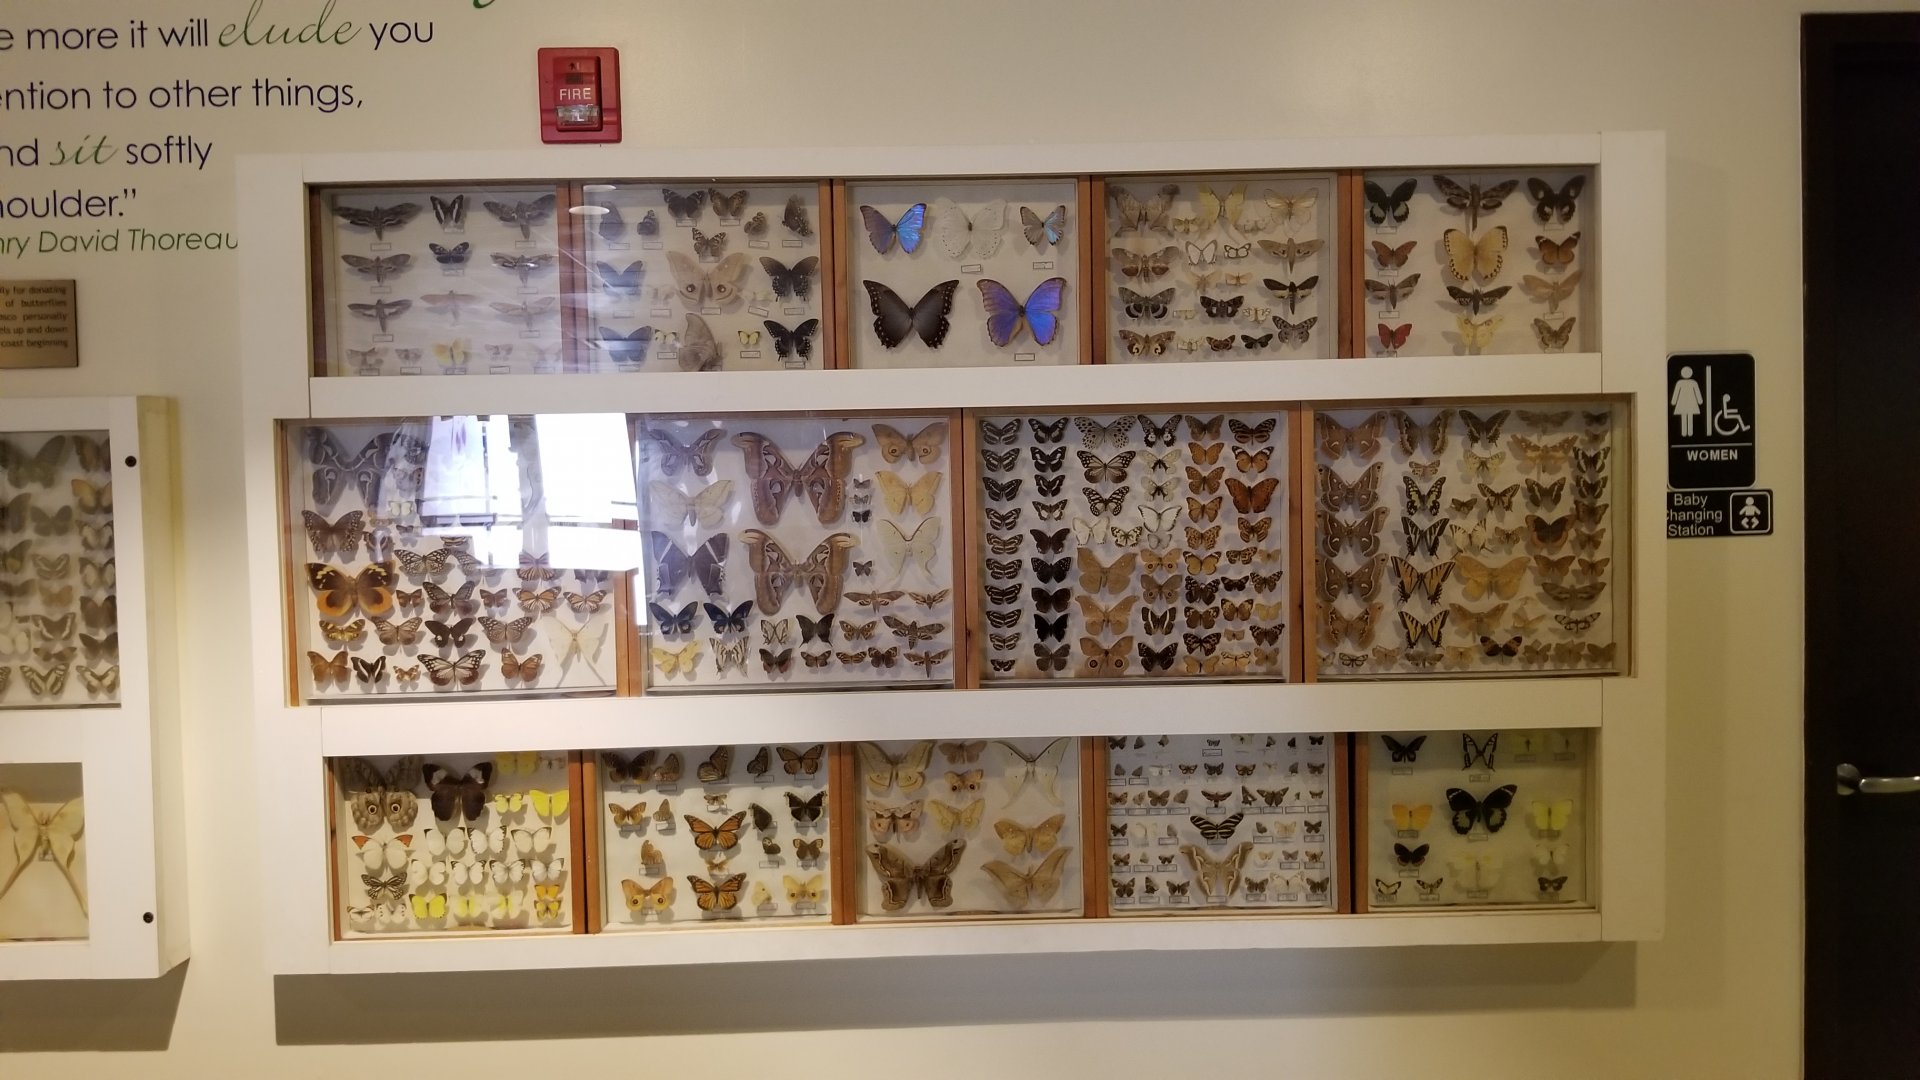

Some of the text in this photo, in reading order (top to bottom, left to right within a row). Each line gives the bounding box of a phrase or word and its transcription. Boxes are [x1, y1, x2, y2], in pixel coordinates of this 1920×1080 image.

[27, 28, 119, 50] more
[130, 20, 148, 48] it
[157, 18, 208, 47] will
[218, 0, 362, 47] elude
[369, 21, 433, 50] you
[0, 77, 363, 113] ntion to other things,
[559, 87, 592, 101] FIRE
[49, 134, 119, 165] sit
[126, 135, 212, 170] softly
[39, 229, 119, 253] David
[128, 228, 238, 251] Thoreau
[1687, 449, 1738, 461] WOMEN
[1674, 493, 1708, 508] Baby
[1668, 523, 1714, 537] Station
